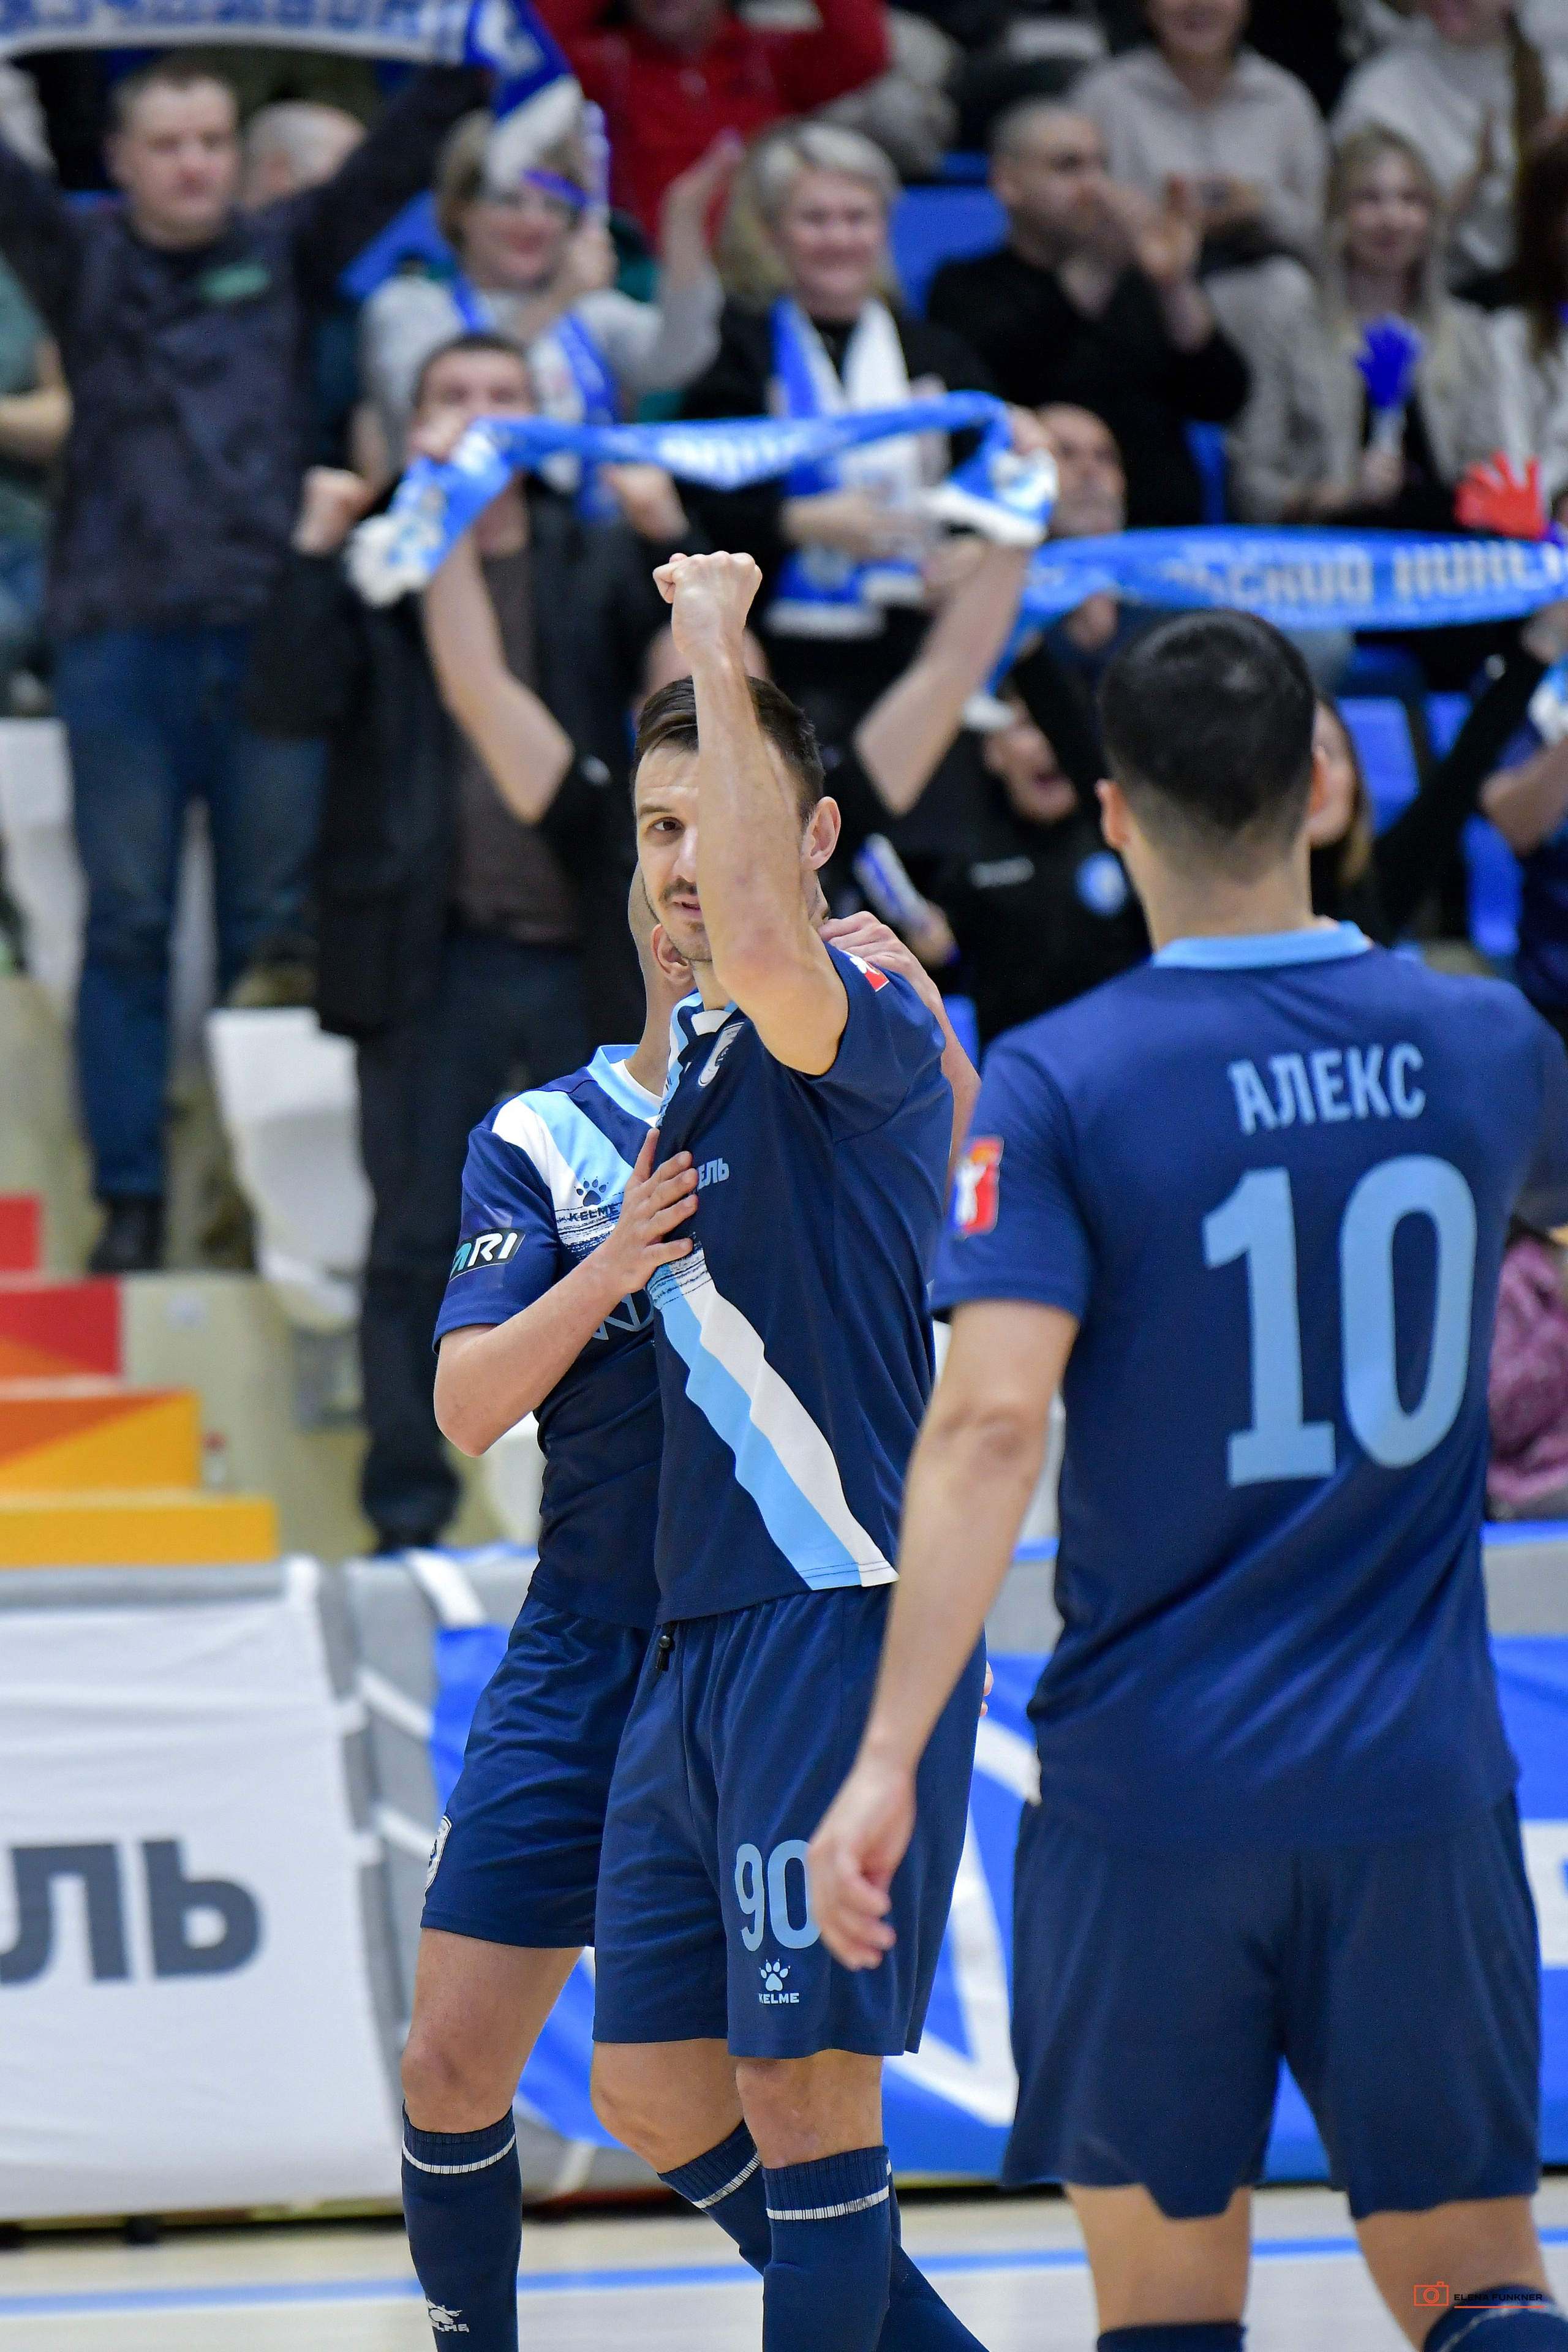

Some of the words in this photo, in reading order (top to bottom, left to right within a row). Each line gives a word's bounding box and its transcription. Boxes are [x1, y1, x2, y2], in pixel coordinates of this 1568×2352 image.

[1227, 1042, 1427, 1135] АЛЕКС
[697, 1157, 729, 1191] ЕЛЬ
[569, 1204, 619, 1222] KELME
[1201, 1153, 1478, 1488] 10
[734, 1839, 822, 1952] 90
[758, 1992, 800, 2004] KELME
